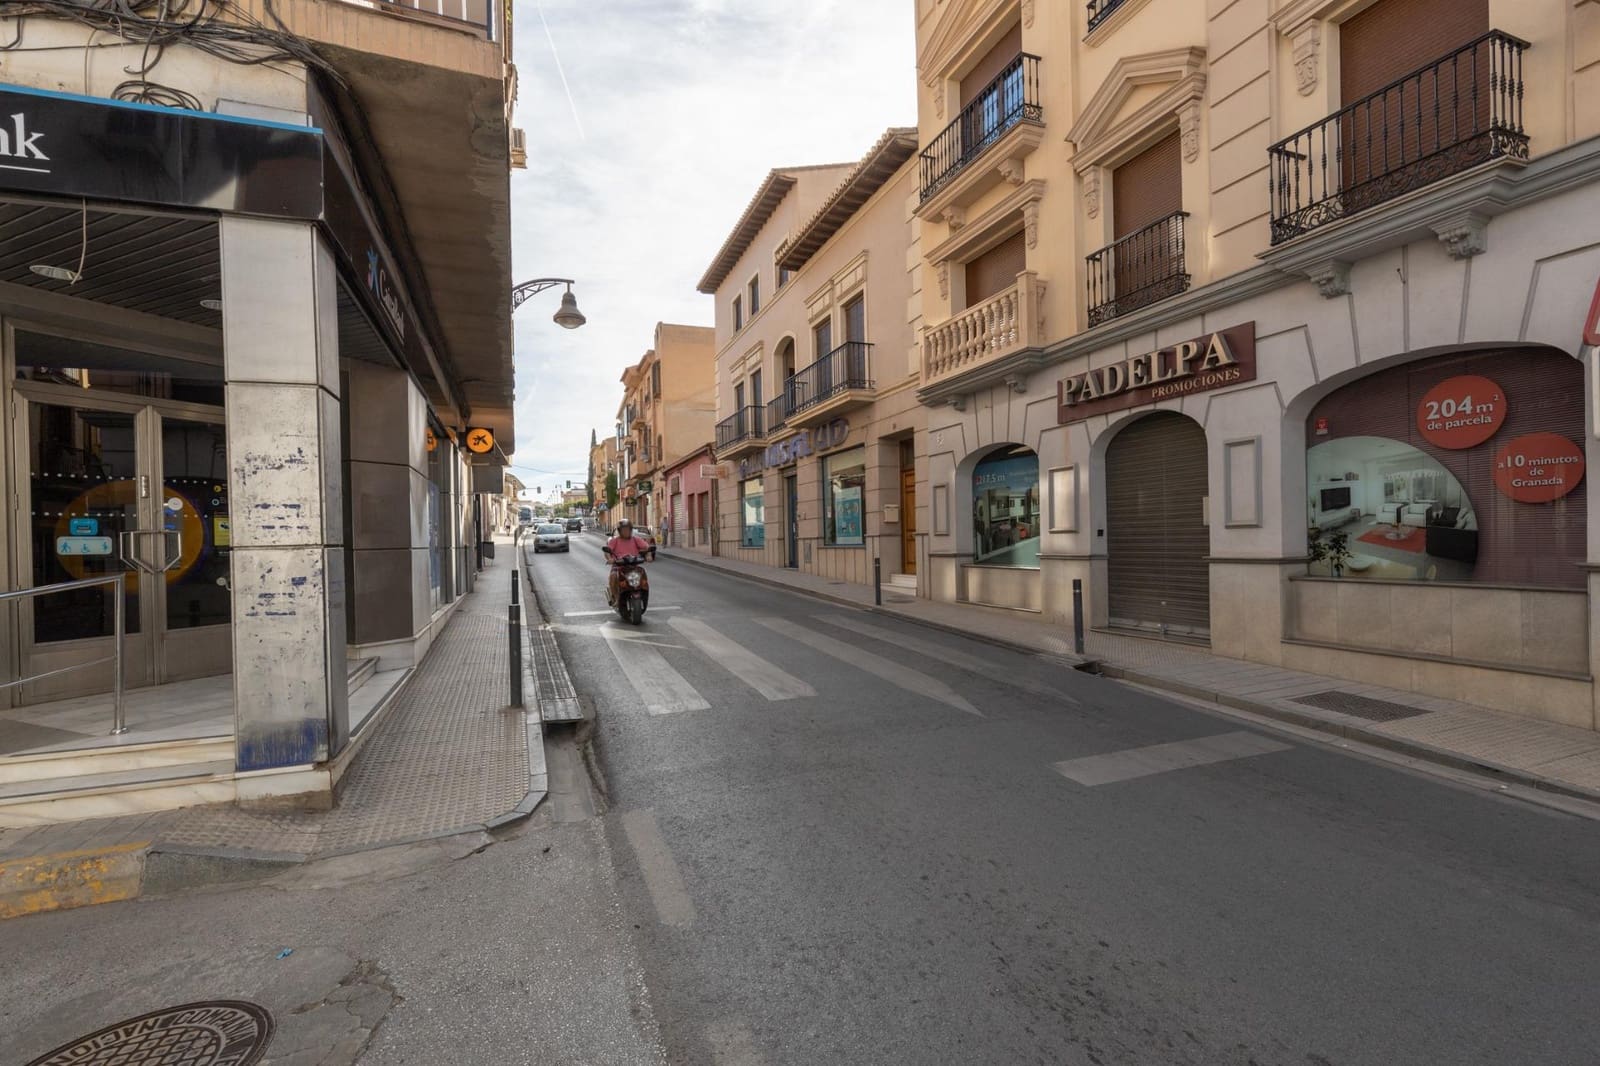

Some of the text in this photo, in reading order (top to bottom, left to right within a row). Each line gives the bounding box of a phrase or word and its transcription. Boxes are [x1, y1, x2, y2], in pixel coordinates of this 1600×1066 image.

[1062, 332, 1239, 408] PADELPA
[1151, 367, 1241, 399] PROMOCIONES
[1425, 395, 1473, 420] 204
[1427, 414, 1492, 431] de parcela
[1528, 455, 1579, 467] minutos
[1529, 467, 1544, 476] de
[1511, 476, 1563, 488] Granada
